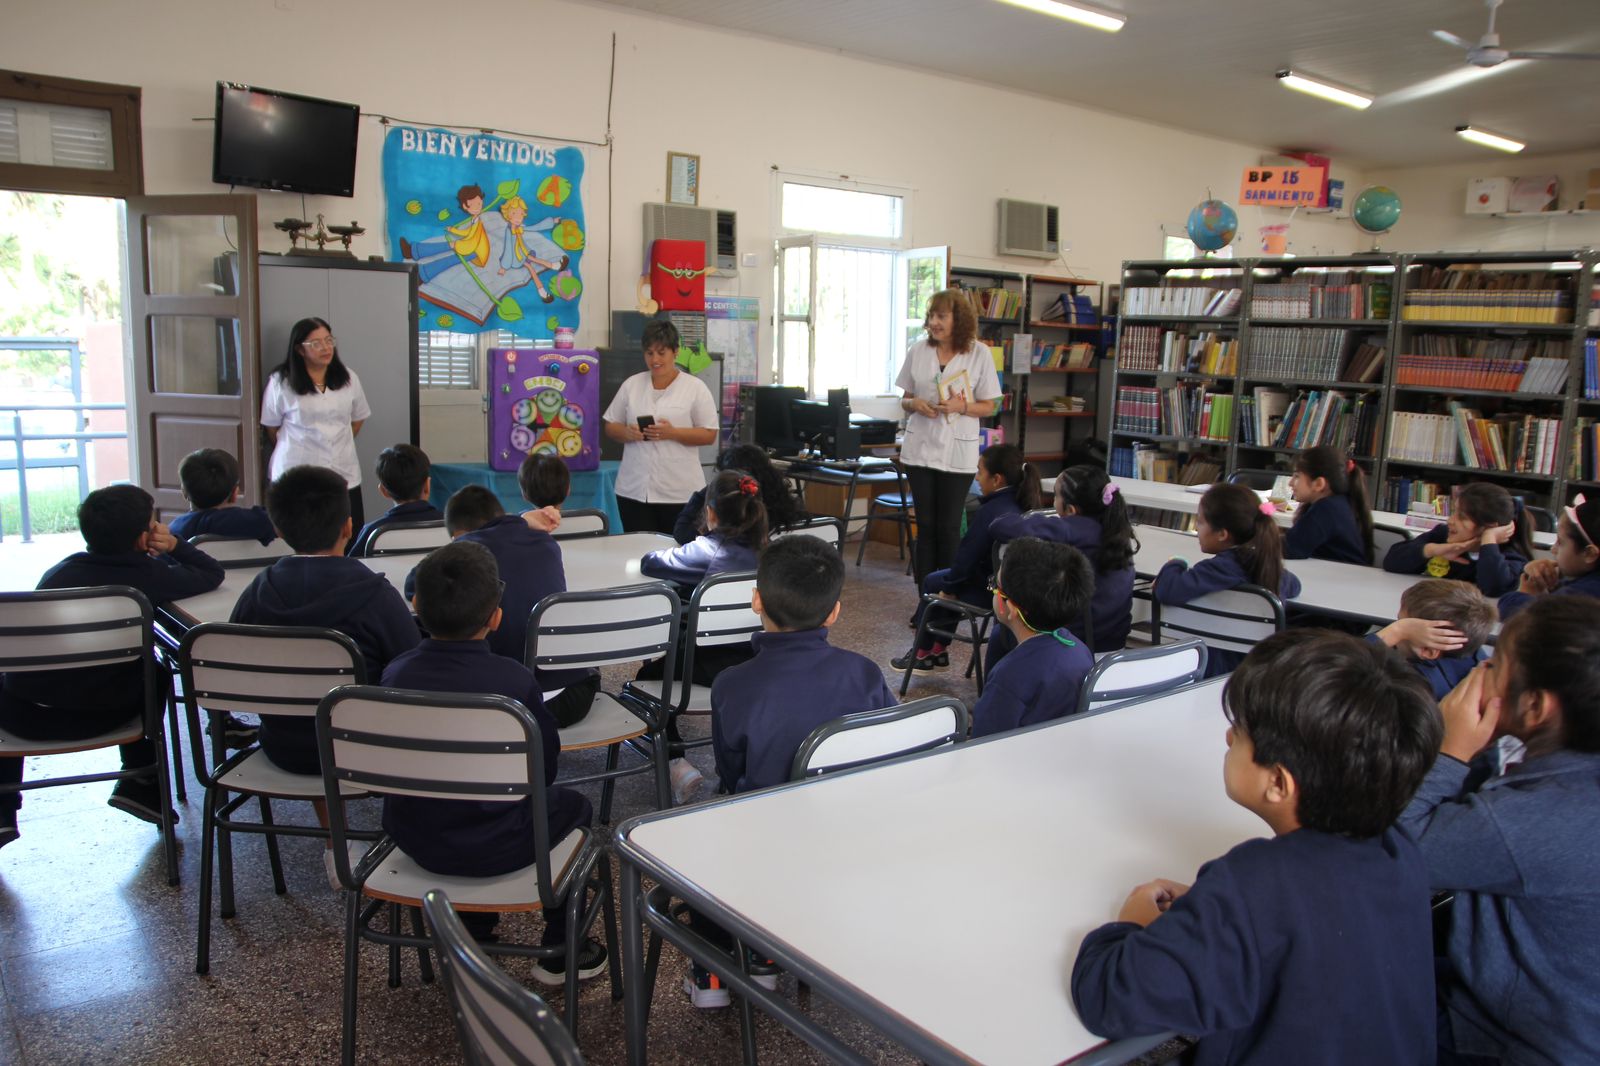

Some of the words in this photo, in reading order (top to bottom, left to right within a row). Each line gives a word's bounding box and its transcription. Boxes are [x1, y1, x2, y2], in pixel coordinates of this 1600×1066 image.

[401, 129, 557, 168] BIENVENIDOS
[538, 174, 562, 208] A
[1248, 170, 1273, 183] BP
[1281, 170, 1300, 185] 15
[1245, 190, 1314, 201] SARMIENTO
[561, 219, 582, 250] B
